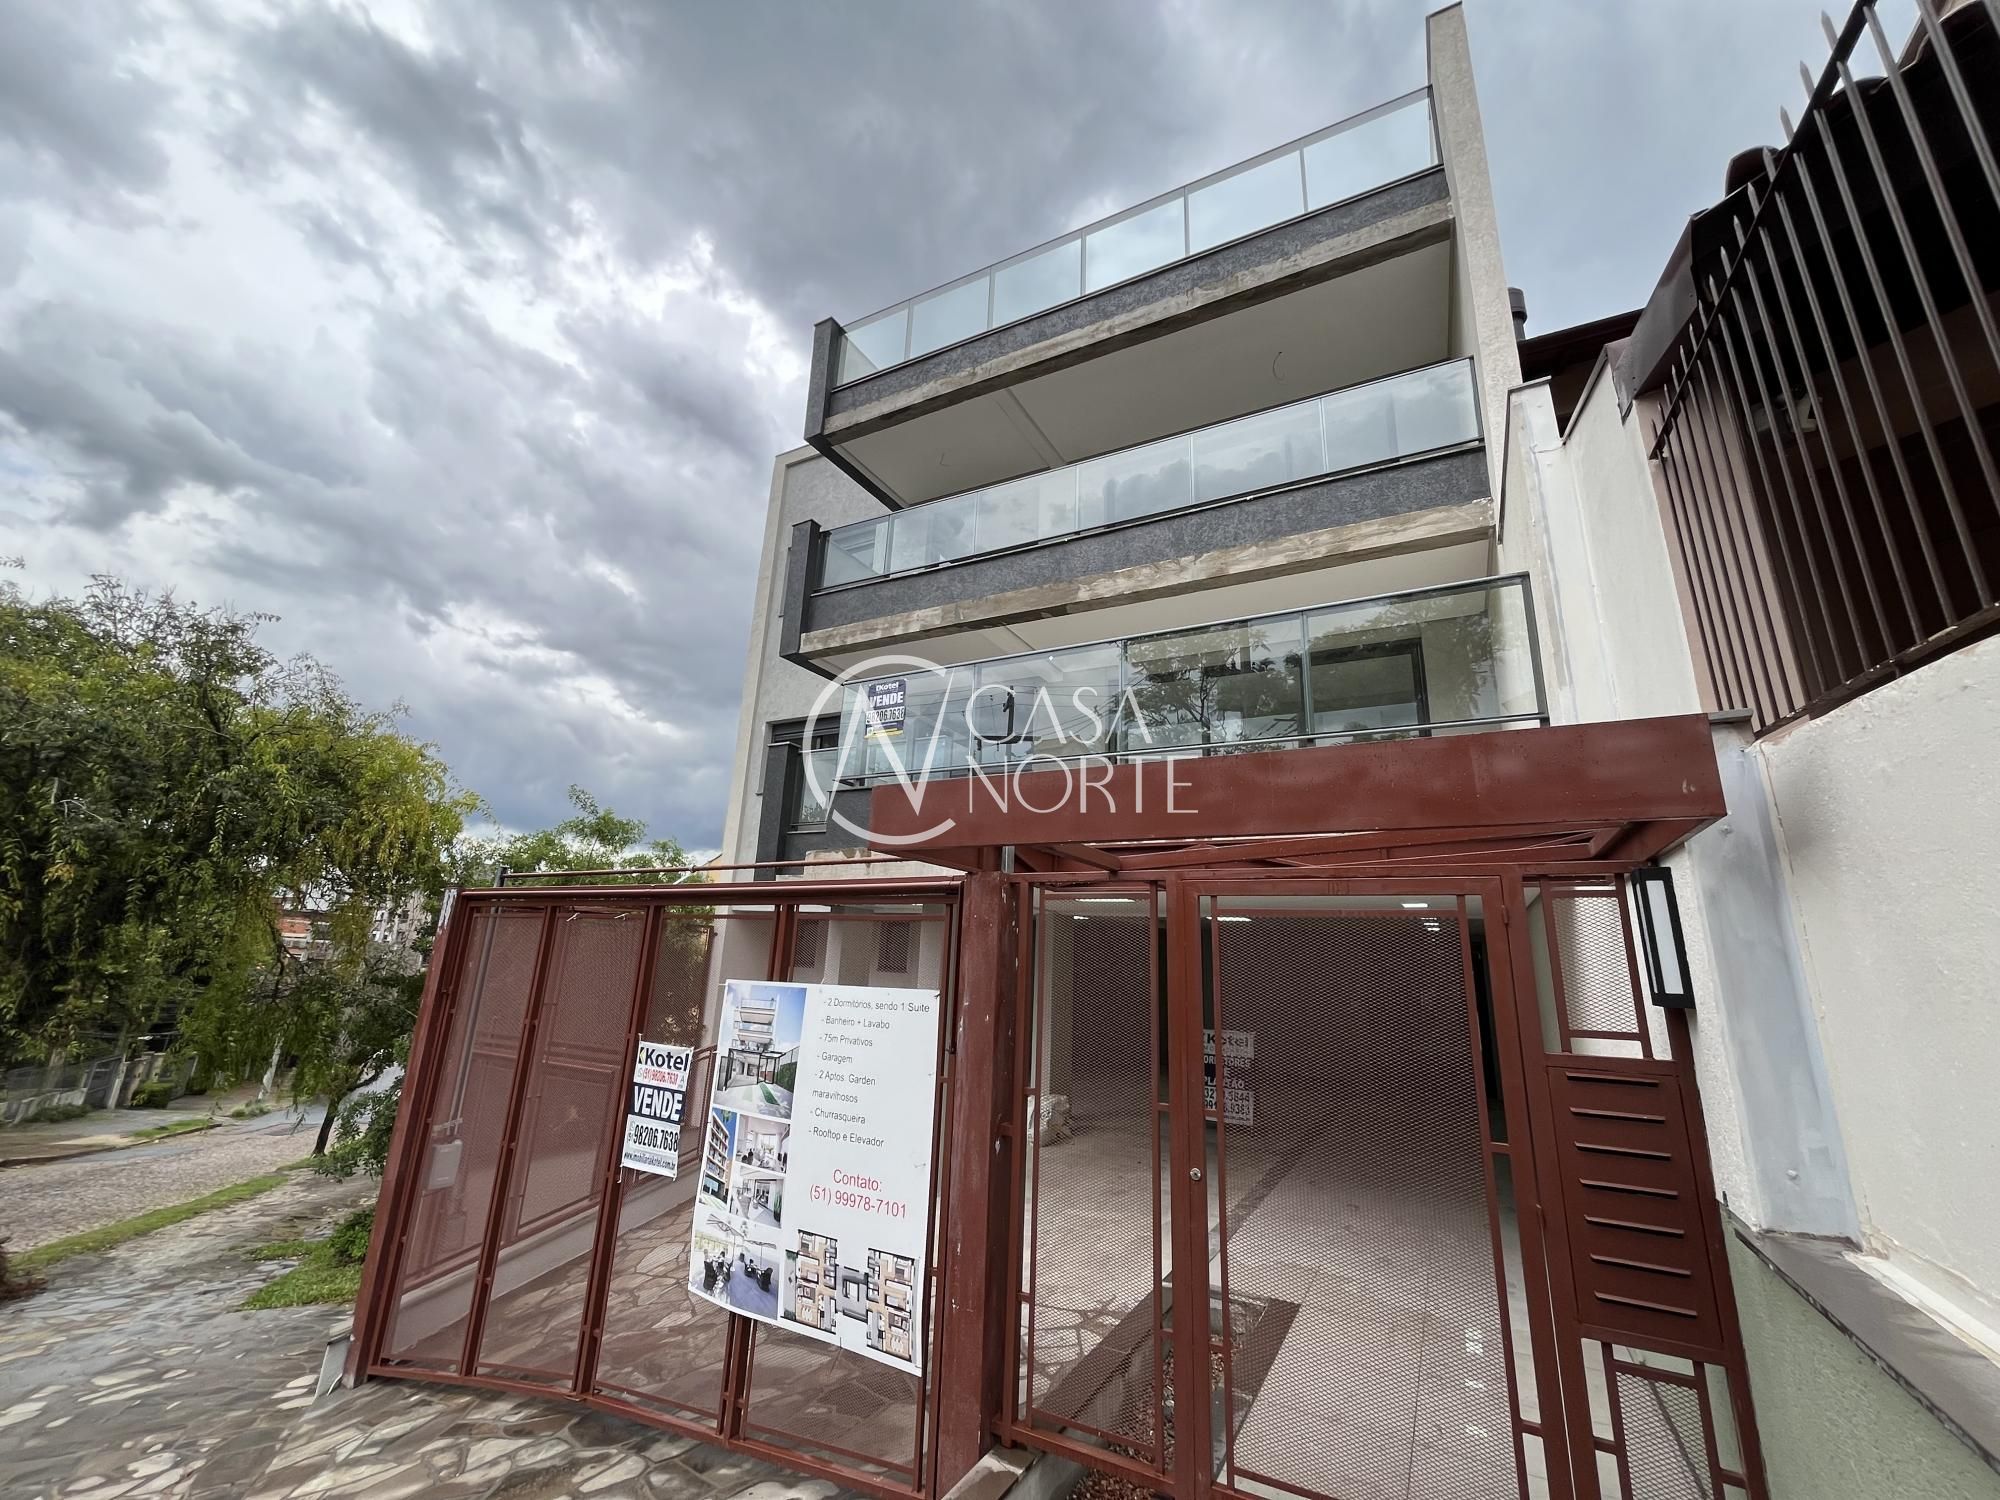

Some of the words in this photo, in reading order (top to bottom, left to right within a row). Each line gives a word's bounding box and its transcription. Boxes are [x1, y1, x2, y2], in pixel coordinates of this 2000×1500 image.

[870, 692, 904, 708] VENDE
[828, 998, 833, 1007] 2
[875, 1002, 898, 1011] sendo
[901, 1002, 905, 1011] 1
[825, 1015, 855, 1026] Banheiro
[863, 1018, 890, 1029] Lavabo
[840, 1034, 873, 1047] Privativos
[645, 1047, 690, 1072] Kotel
[822, 1051, 853, 1064] Garagem
[819, 1069, 824, 1079] 2
[825, 1071, 845, 1082] Aptos
[849, 1073, 876, 1086] Garden
[634, 1085, 683, 1122] VENDE
[812, 1089, 858, 1103] maravilhosos
[815, 1107, 866, 1124] Churrasqueira
[633, 1124, 679, 1153] 98206.7638
[813, 1126, 841, 1142] Rooftop
[843, 1133, 848, 1141] e
[849, 1132, 884, 1147] Elevador
[833, 1168, 882, 1192] Contato:
[809, 1184, 832, 1206] (51)
[835, 1190, 906, 1219] 99978-7101
